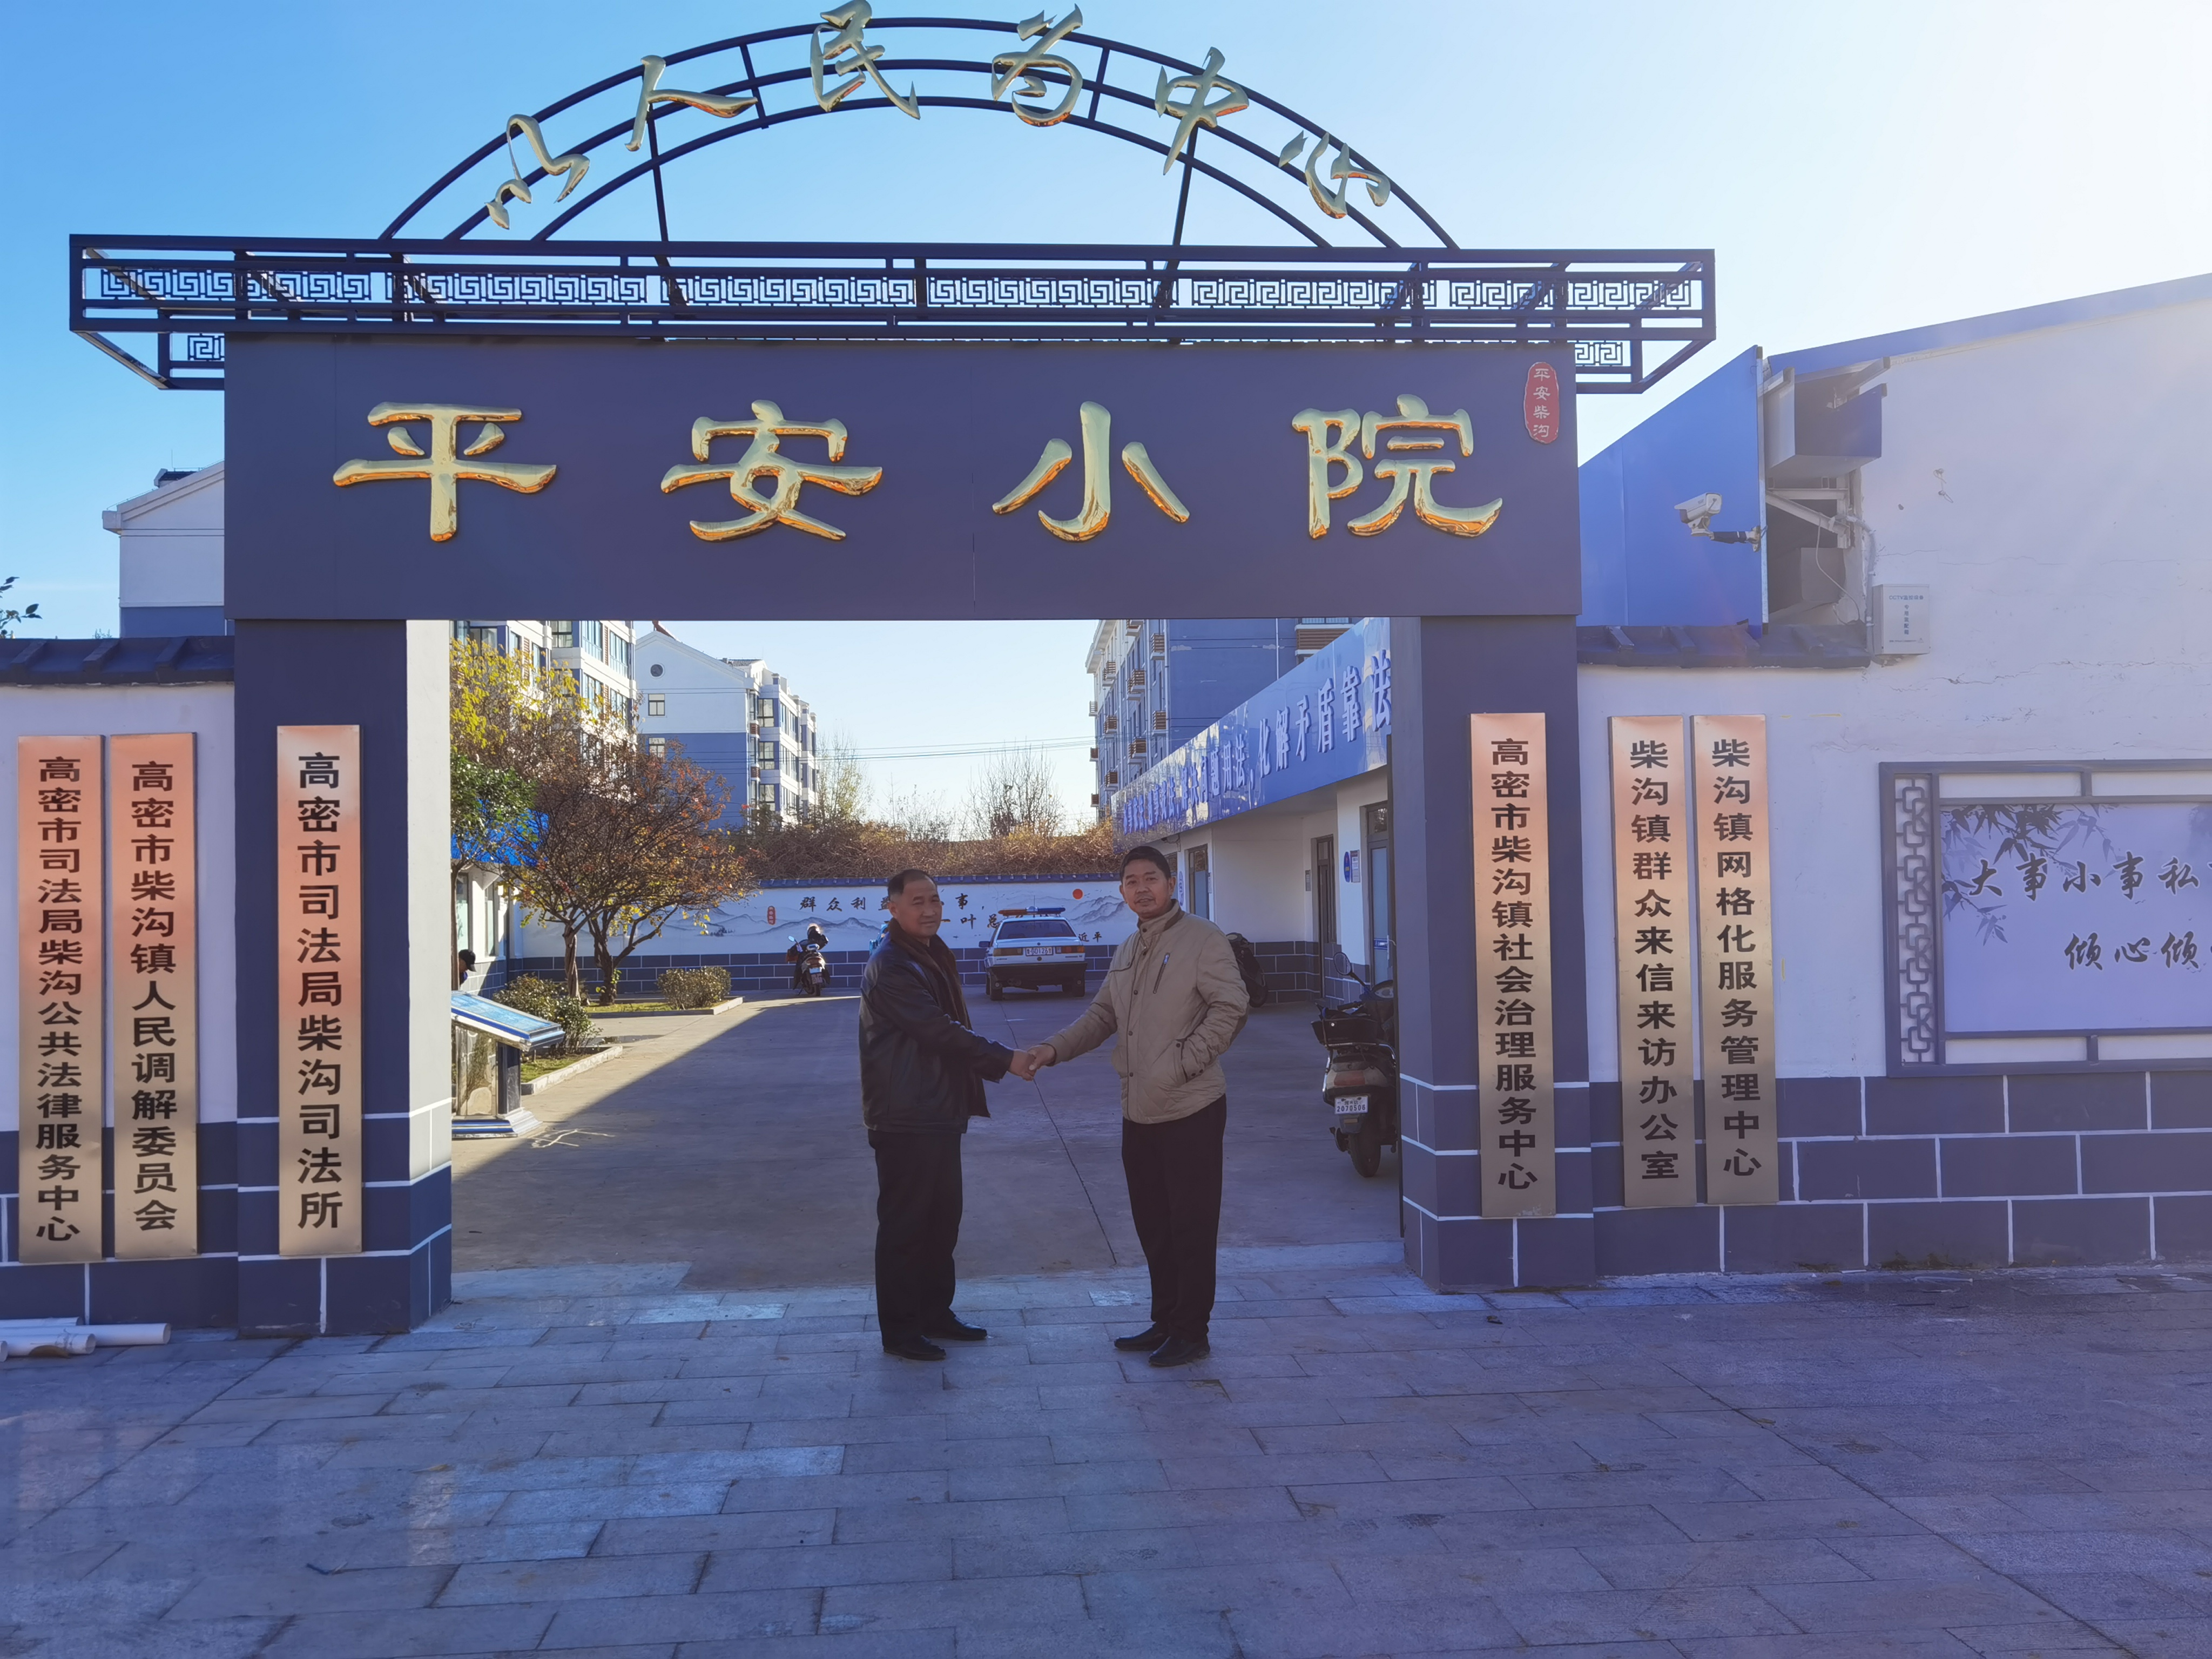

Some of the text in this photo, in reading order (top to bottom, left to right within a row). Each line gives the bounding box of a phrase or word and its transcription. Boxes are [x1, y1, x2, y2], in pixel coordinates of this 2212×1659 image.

[333, 396, 1503, 542] 平安小院
[1533, 368, 1550, 437] 平安柴沟
[36, 757, 82, 1242] 高密市司法局柴沟公共法律服务中心
[130, 761, 178, 1231] 高密市柴沟镇人民调解委员会
[297, 752, 342, 1229] 高密市司法局柴沟司法所
[1491, 738, 1537, 1190] 高密市柴沟镇社会治理服务中心
[1630, 740, 1678, 1179] 柴沟镇群众来信来访办公室
[1712, 739, 1761, 1176] 柴沟镇网格化服务管理中心
[1968, 852, 2212, 901] 大事小事私
[2064, 931, 2212, 970] 倾心倾
